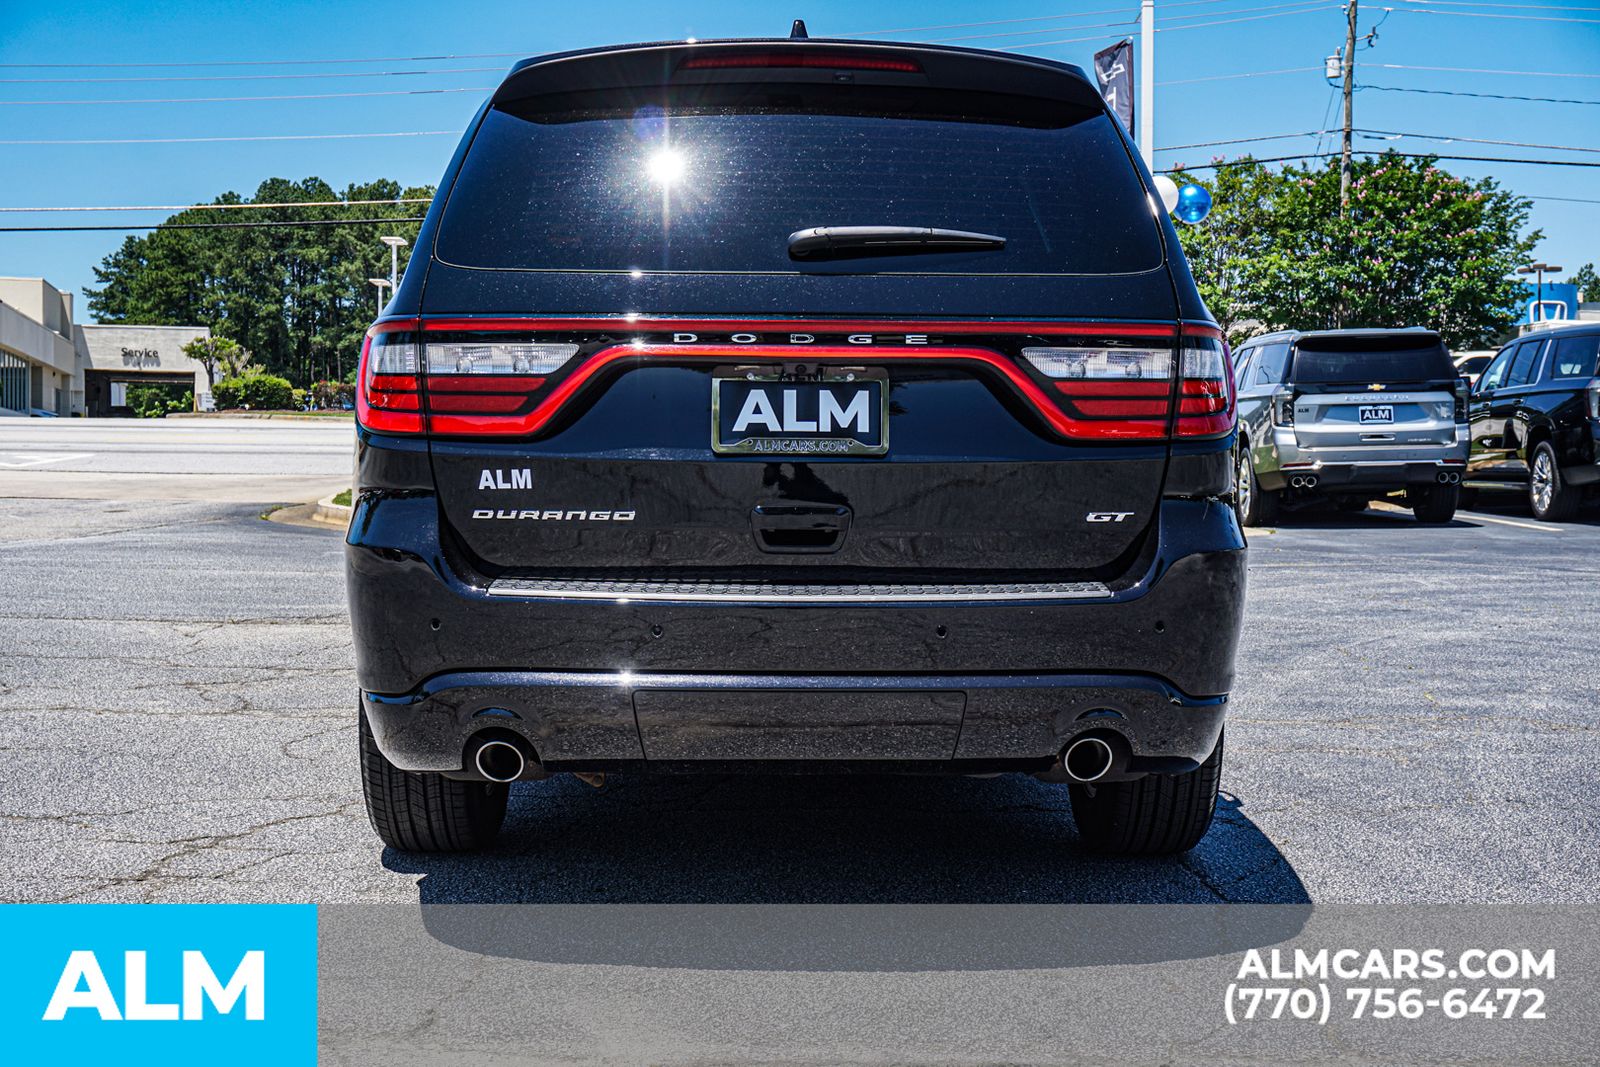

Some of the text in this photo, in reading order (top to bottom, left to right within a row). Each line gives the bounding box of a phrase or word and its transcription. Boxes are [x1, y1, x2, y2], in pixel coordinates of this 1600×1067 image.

[674, 333, 927, 344] DODGE
[121, 347, 159, 358] Service
[732, 389, 870, 433] ALM
[1364, 410, 1389, 419] ALM
[753, 440, 849, 452] ALMCARS.COM
[478, 469, 533, 490] ALM
[472, 510, 636, 521] DURANGO
[1086, 512, 1135, 522] GT
